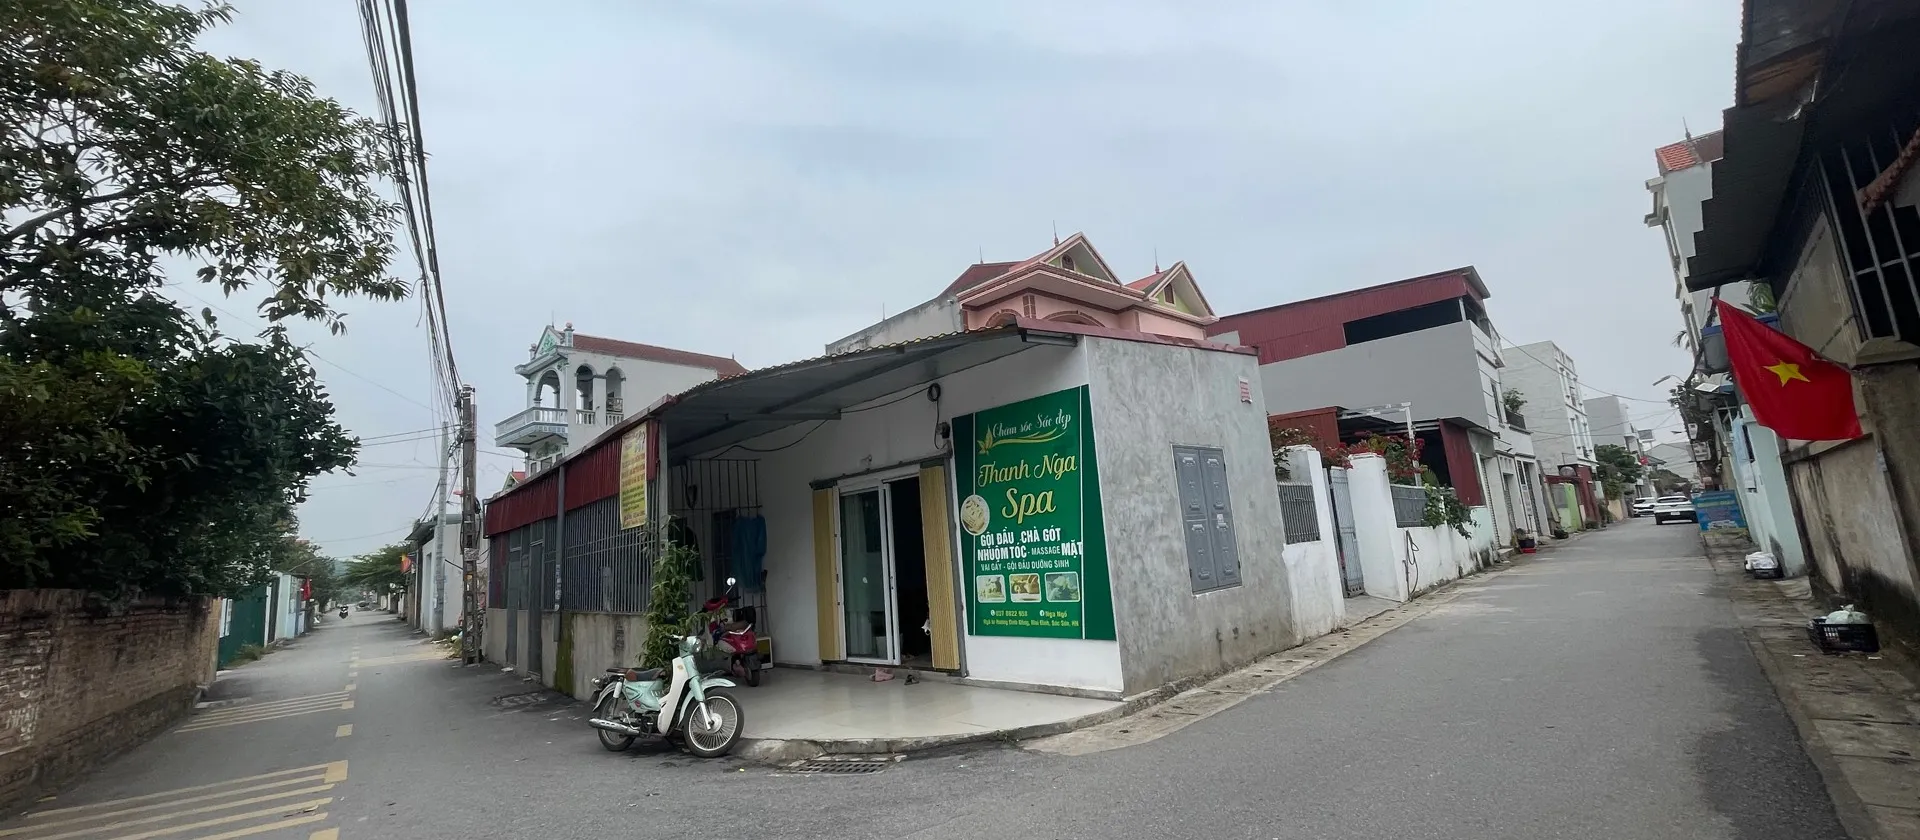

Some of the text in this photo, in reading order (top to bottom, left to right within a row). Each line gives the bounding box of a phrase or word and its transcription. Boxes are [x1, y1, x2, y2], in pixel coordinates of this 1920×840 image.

[978, 452, 1078, 487] Thanh Nga
[1001, 487, 1057, 524] Spa
[980, 524, 1061, 549] GỘI ĐẦU CHÀ GÓT
[977, 545, 1009, 562] NHUỘM
[1009, 542, 1027, 559] TÓC
[1031, 546, 1061, 556] MASSAGE
[1061, 539, 1084, 558] MẶT
[981, 563, 991, 572] VAI
[1054, 559, 1069, 569] SINH
